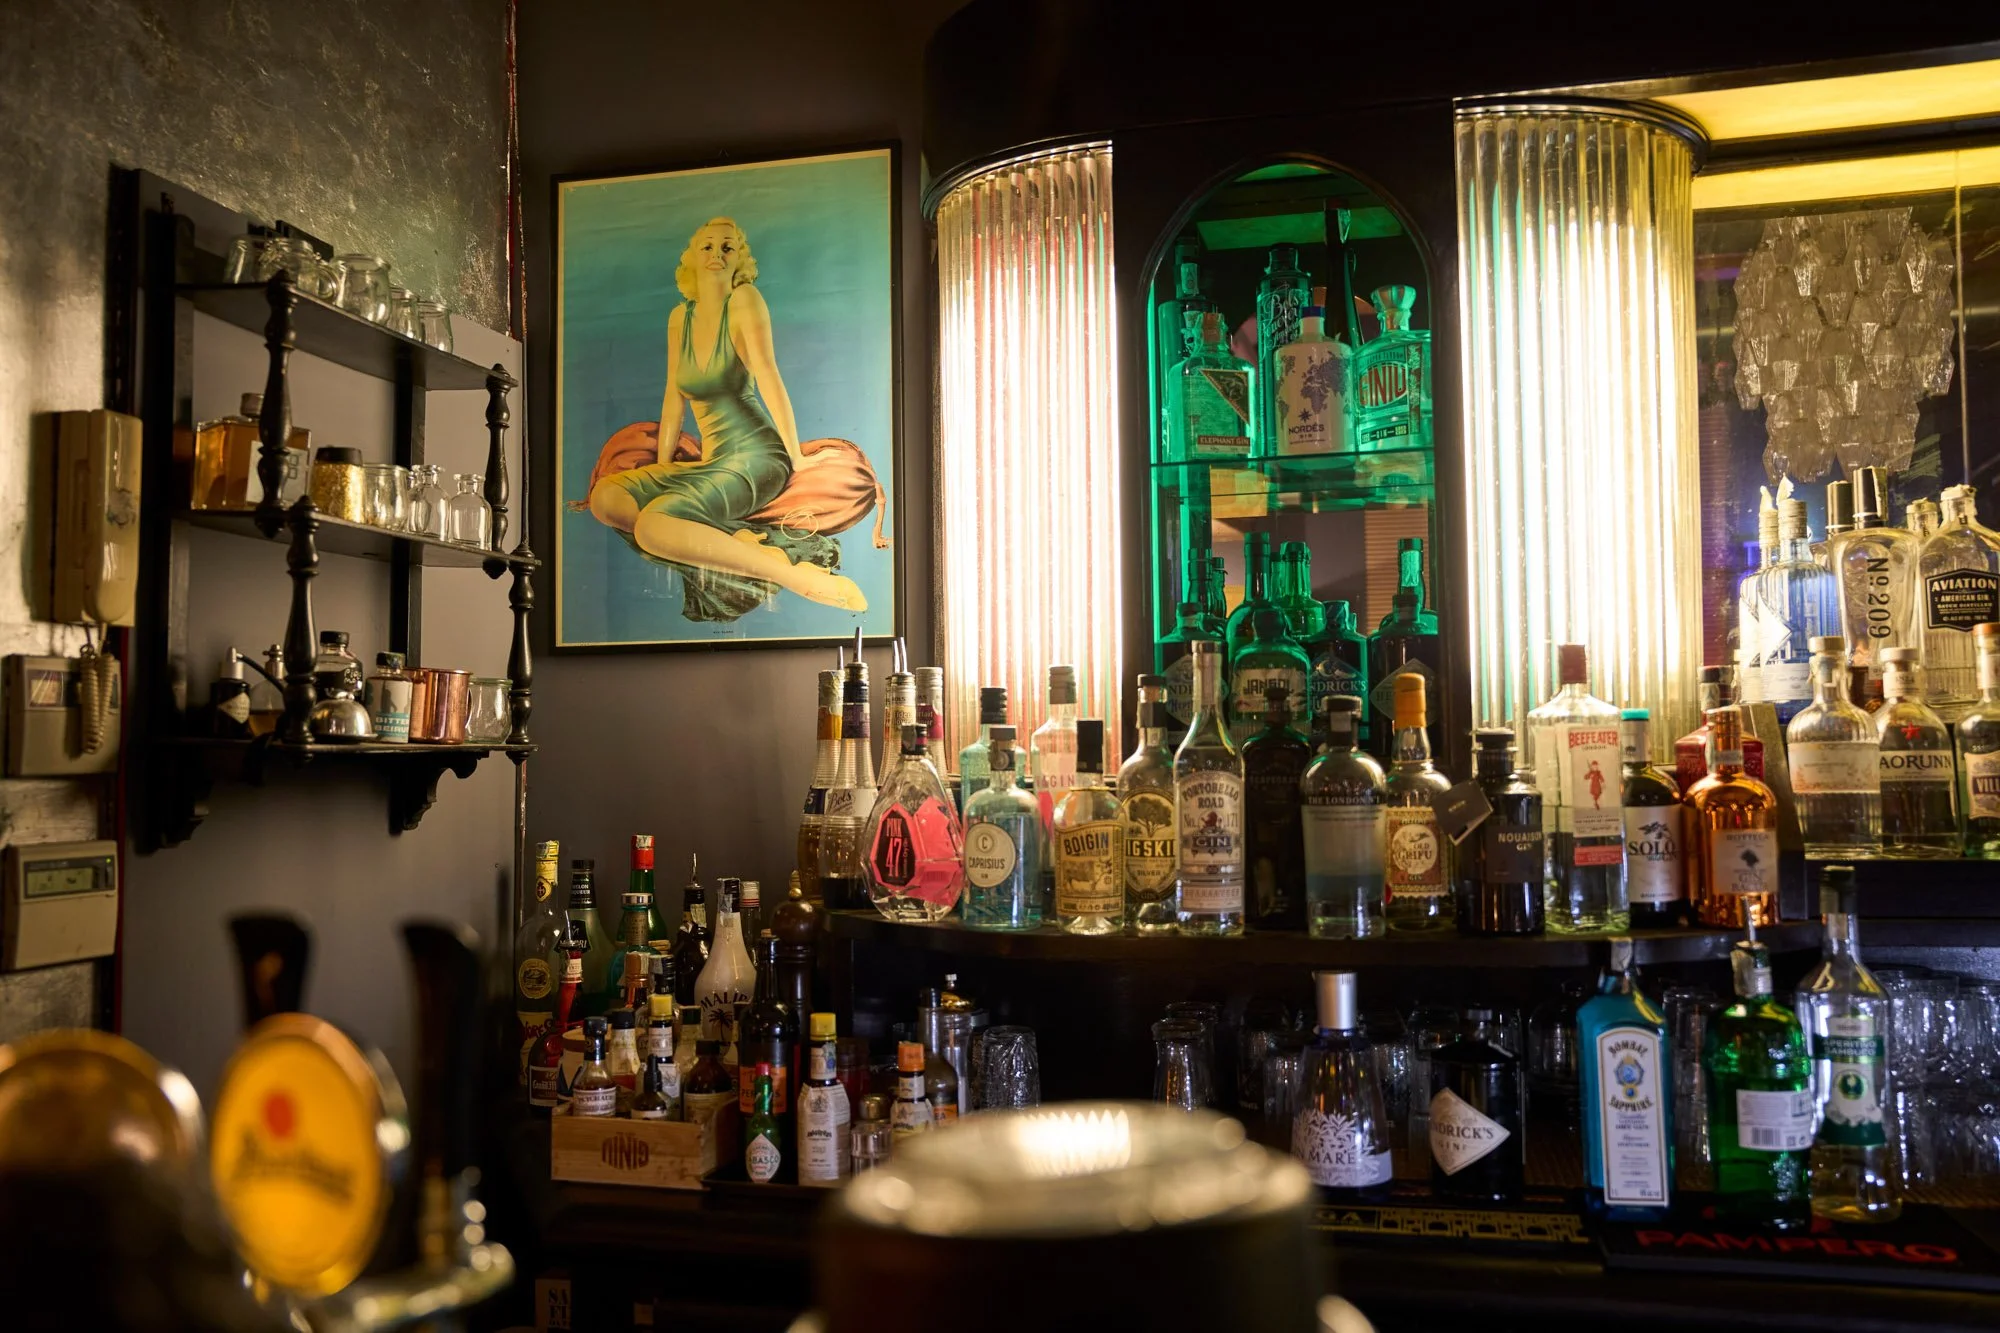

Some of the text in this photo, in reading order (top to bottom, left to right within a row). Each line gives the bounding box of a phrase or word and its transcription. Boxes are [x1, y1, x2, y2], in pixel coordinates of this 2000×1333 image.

[1289, 422, 1324, 434] NORDÉS
[1200, 437, 1233, 445] ELEPHANT
[1931, 578, 1997, 592] AVIATION
[1941, 594, 1975, 602] AMERICAN
[1868, 593, 1892, 639] 209
[1309, 679, 1367, 692] NDRICK'S
[1569, 731, 1618, 748] BEEFEATER
[1879, 755, 1952, 770] AORUNN
[1183, 782, 1239, 801] PORTOBELLO
[1198, 797, 1224, 809] ROAD
[1064, 831, 1109, 856] BOIGIN
[1127, 840, 1174, 858] IGSKI
[1195, 838, 1228, 849] GIN
[1629, 841, 1675, 856] SOLO
[885, 838, 902, 878] 47
[969, 857, 1005, 870] CAPRISIUS
[700, 991, 748, 1012] MALI
[1608, 1040, 1648, 1058] BOMBAY
[1608, 1094, 1653, 1112] SAPPHIRE
[1433, 1121, 1494, 1139] NDRICK'S
[746, 1154, 779, 1165] ABASCO
[1309, 1151, 1356, 1165] MARE
[1636, 1229, 1958, 1263] PAMPERO
